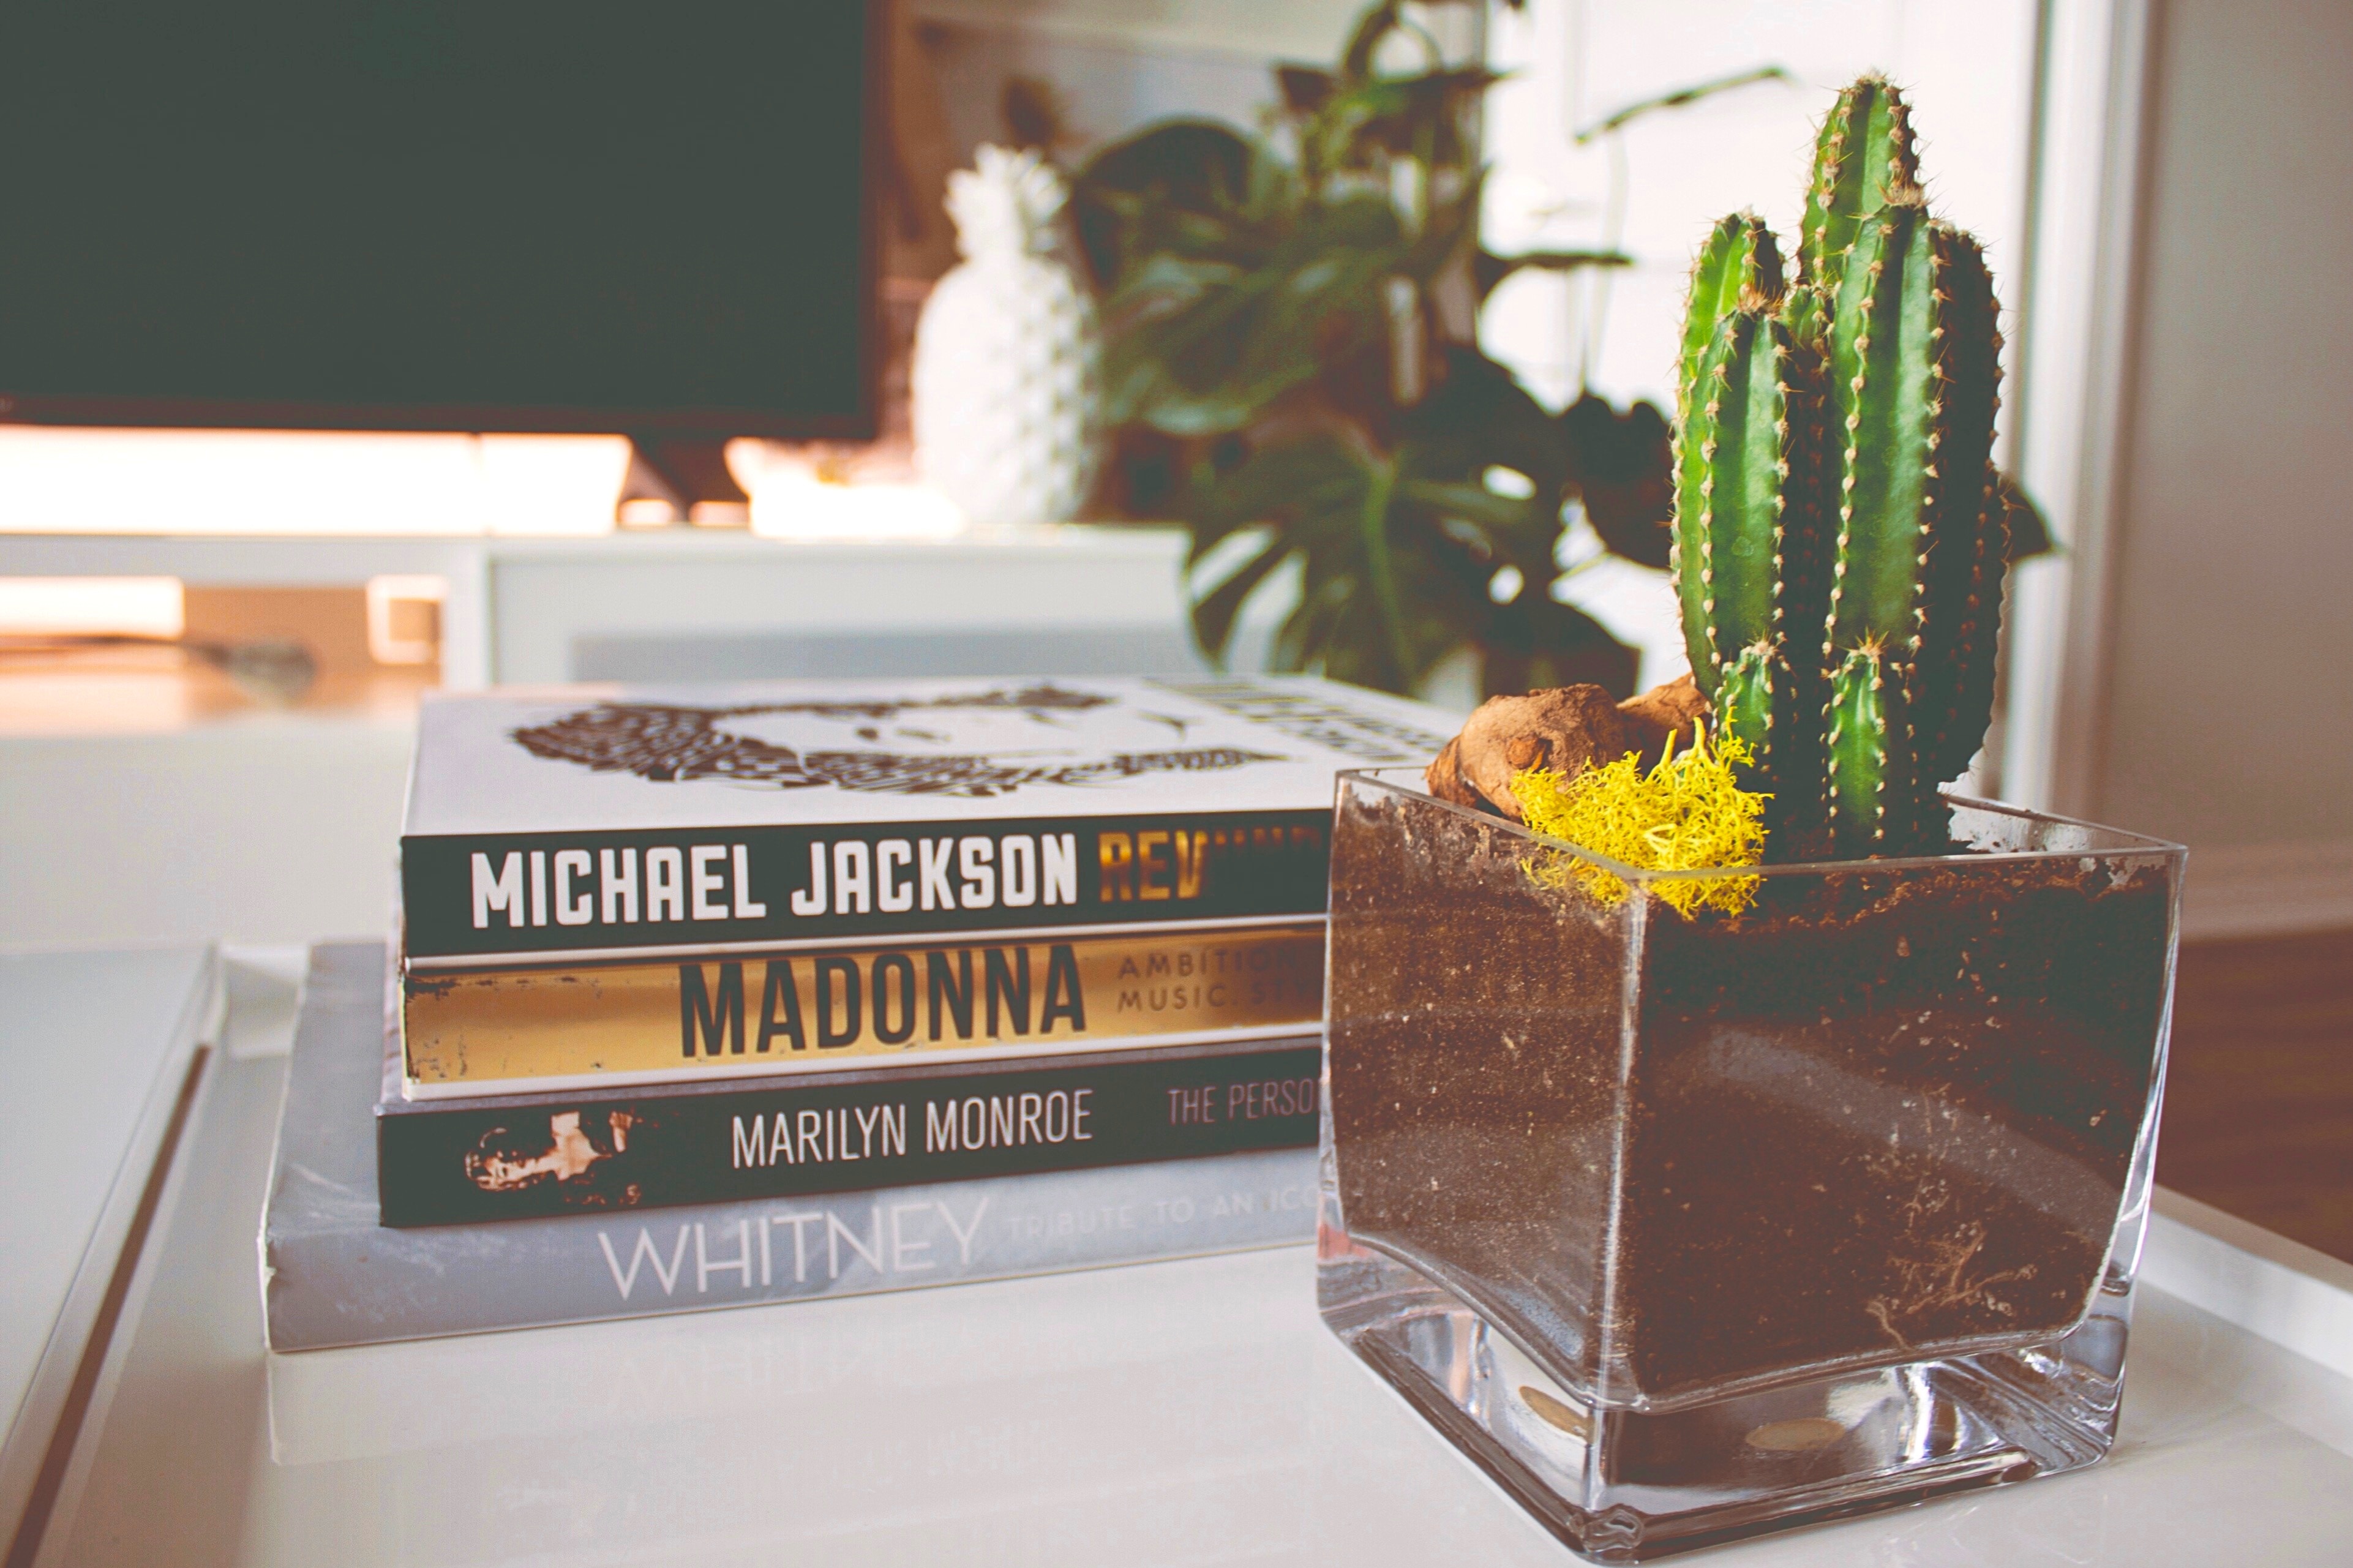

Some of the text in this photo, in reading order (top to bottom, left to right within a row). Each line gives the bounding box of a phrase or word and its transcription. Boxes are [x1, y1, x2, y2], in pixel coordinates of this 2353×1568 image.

[471, 844, 767, 928] MICHAEL
[791, 833, 1077, 916] JACKSON
[679, 944, 1085, 1057] MADONNA
[733, 1078, 1321, 1169] MARILYN MONROE THE PERSO
[598, 1182, 1319, 1300] WHITNEY TRIBUTE TO AN ICO
